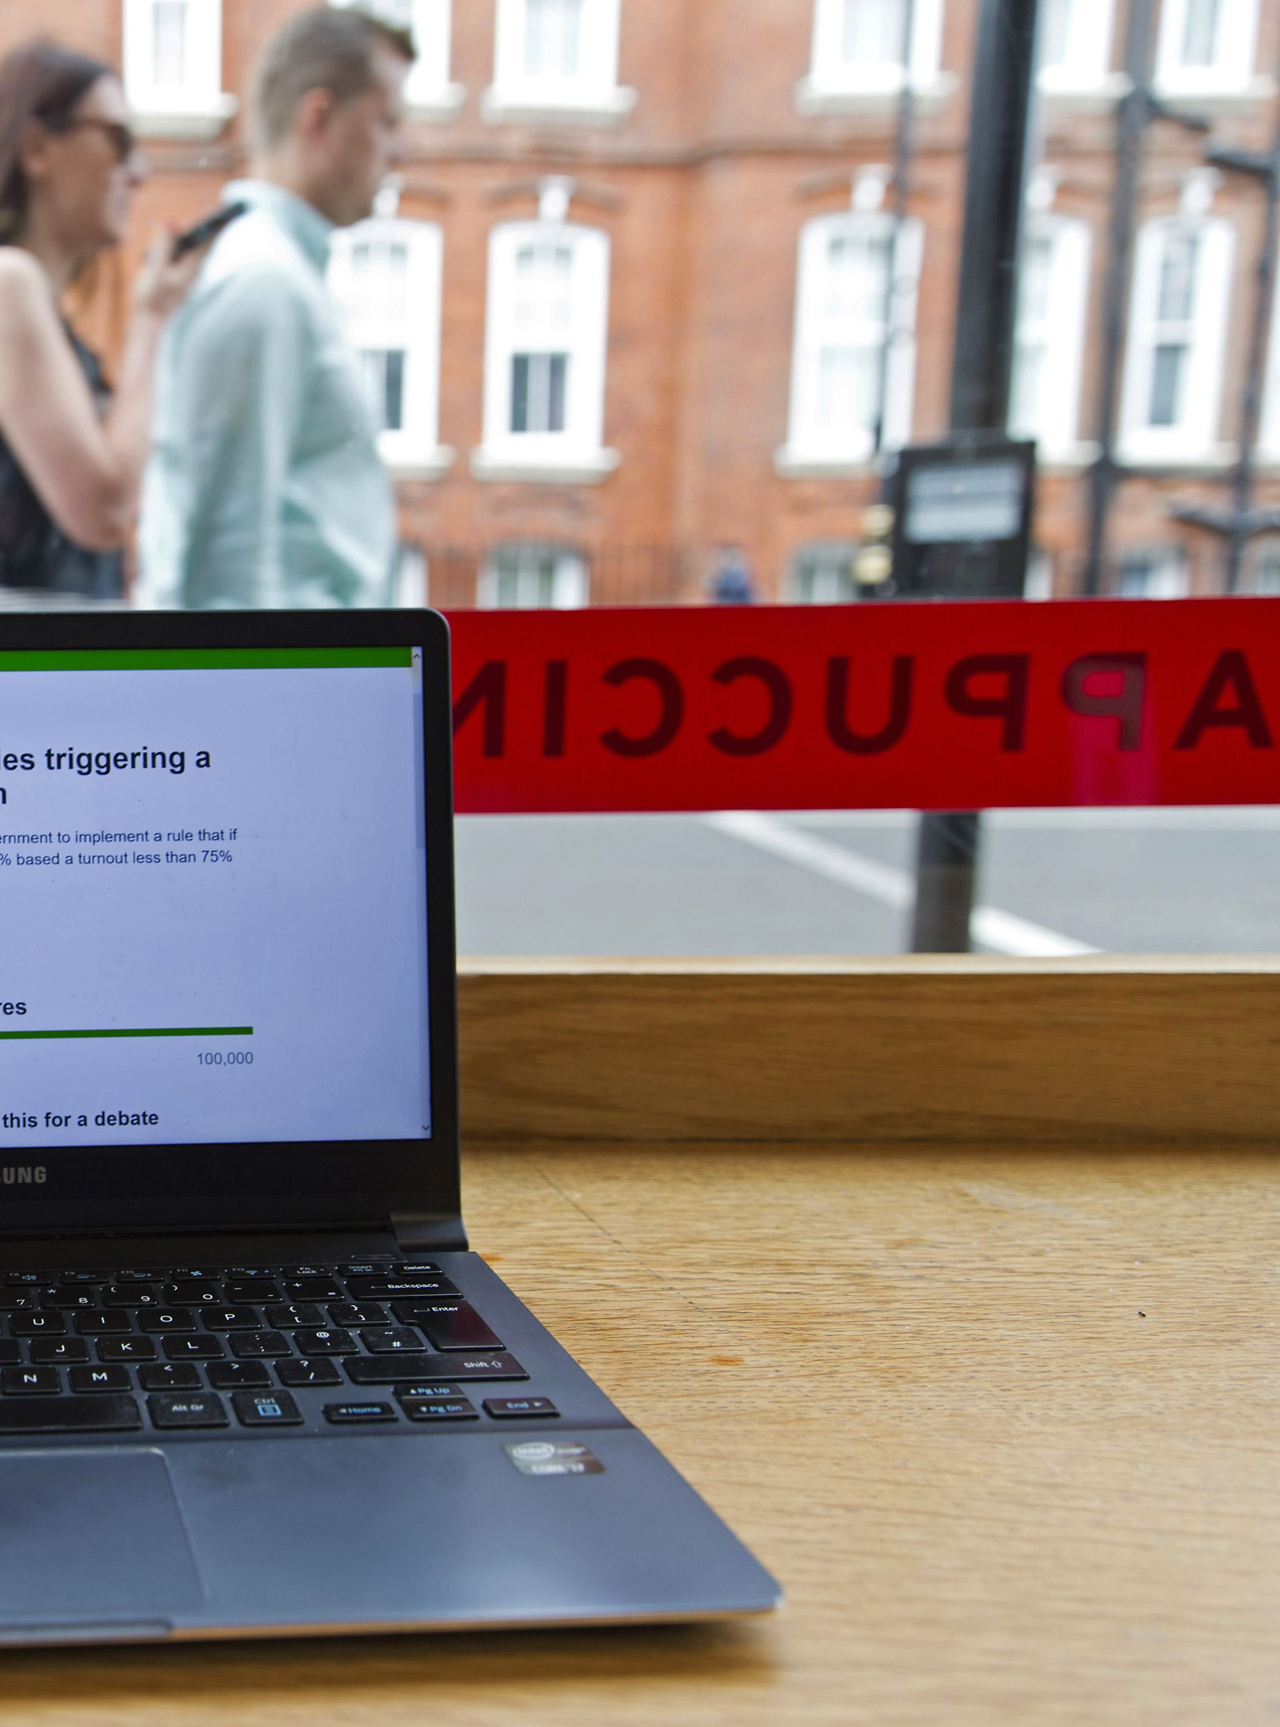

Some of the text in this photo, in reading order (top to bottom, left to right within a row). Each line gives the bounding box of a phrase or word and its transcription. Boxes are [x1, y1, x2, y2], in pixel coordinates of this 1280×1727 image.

[45, 746, 185, 775] triggering
[196, 751, 210, 768] a
[57, 832, 70, 843] to
[76, 830, 149, 846] implement
[154, 833, 162, 842] a
[167, 829, 193, 841] rule
[198, 829, 225, 841] that
[229, 828, 238, 840] if
[17, 853, 59, 865] based
[65, 856, 73, 864] a
[78, 852, 128, 864] turnout
[133, 852, 161, 863] less
[165, 851, 196, 863] than
[201, 850, 233, 862] 75%
[197, 1052, 253, 1066] 100,000
[2, 1113, 38, 1128] this
[44, 1112, 71, 1127] for
[77, 1115, 87, 1126] a
[95, 1111, 159, 1126] debate
[202, 1293, 214, 1301] 0
[100, 1316, 106, 1324] I
[159, 1315, 173, 1323] O
[224, 1313, 236, 1321] P
[32, 1318, 45, 1326] U
[55, 1344, 66, 1353] J
[120, 1342, 133, 1351] K
[187, 1341, 199, 1350] L
[23, 1374, 38, 1383] N
[92, 1372, 108, 1382] M
[415, 1387, 451, 1396] Pg Up
[171, 1404, 189, 1412] Alt
[506, 1401, 530, 1410] End
[429, 1406, 447, 1415] Pg
